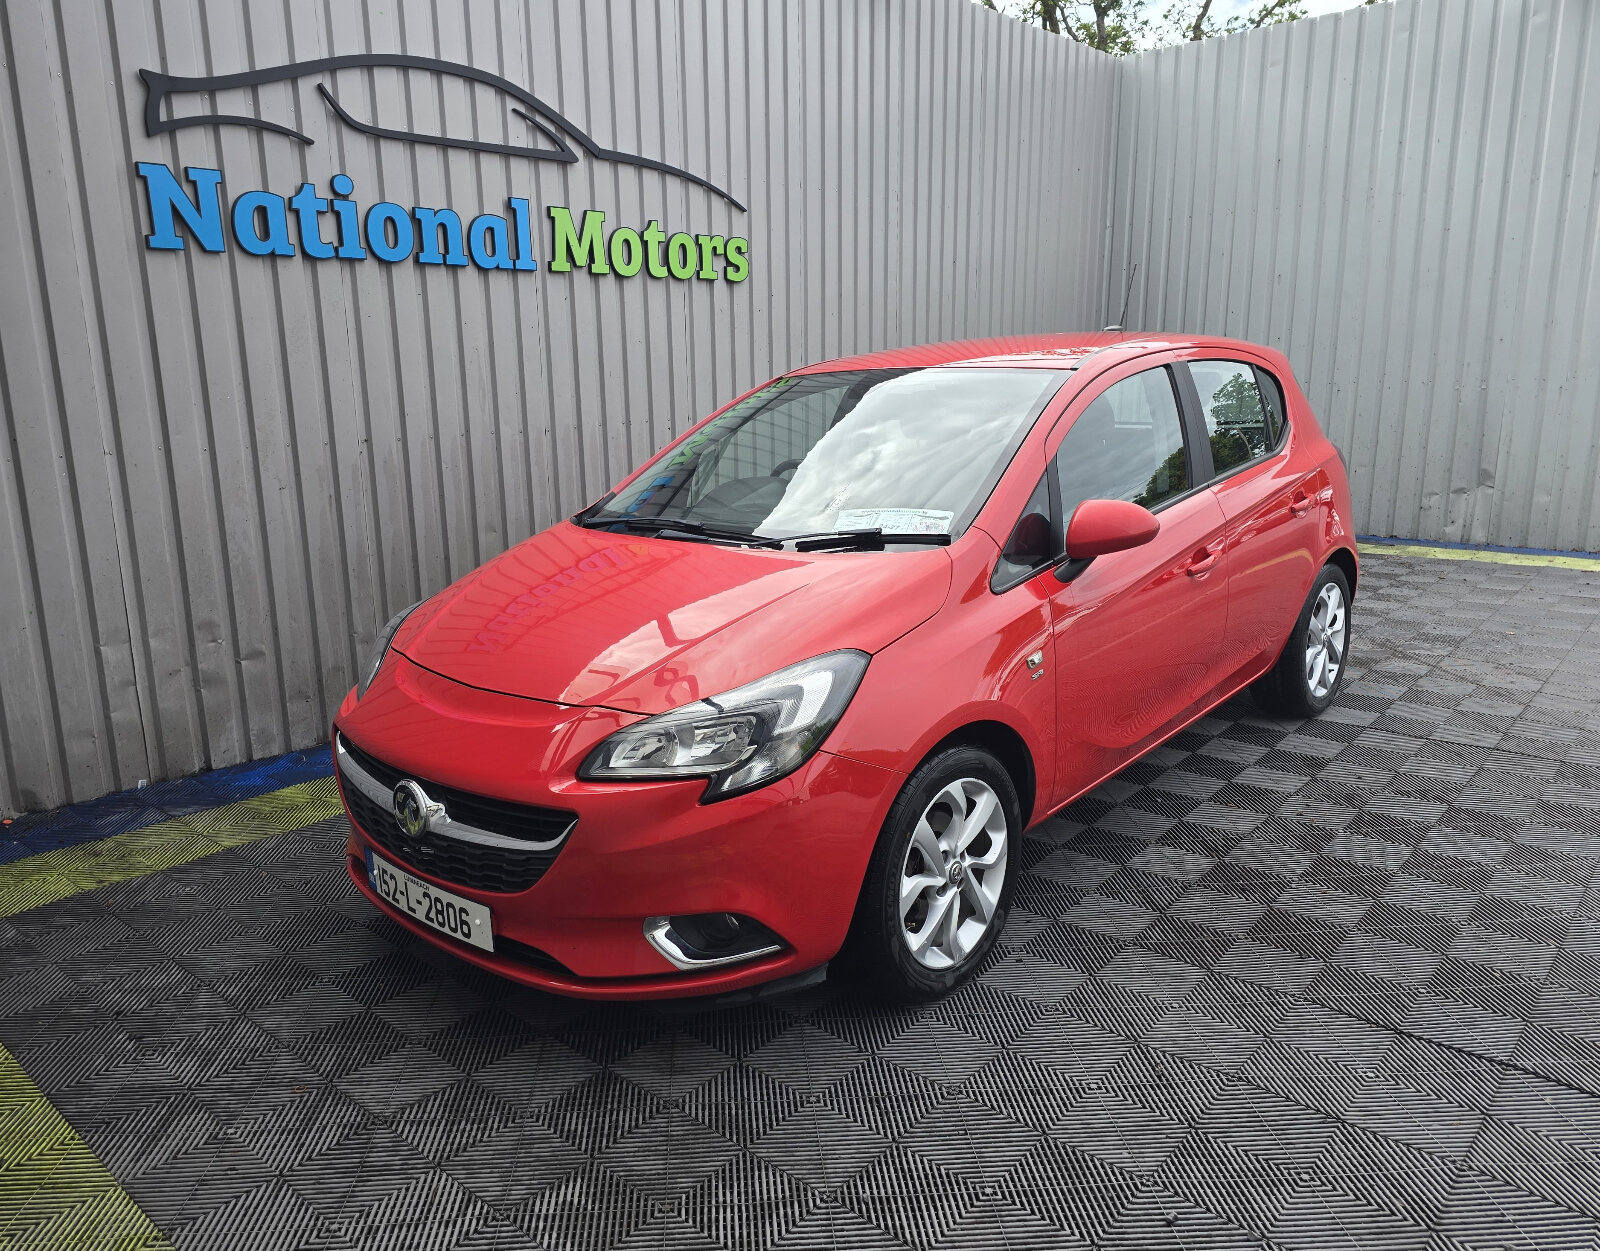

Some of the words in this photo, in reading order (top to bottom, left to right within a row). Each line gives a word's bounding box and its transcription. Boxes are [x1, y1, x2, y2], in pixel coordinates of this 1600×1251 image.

[135, 161, 538, 272] National
[547, 205, 750, 283] Motors
[377, 864, 472, 939] 152-L-2806
